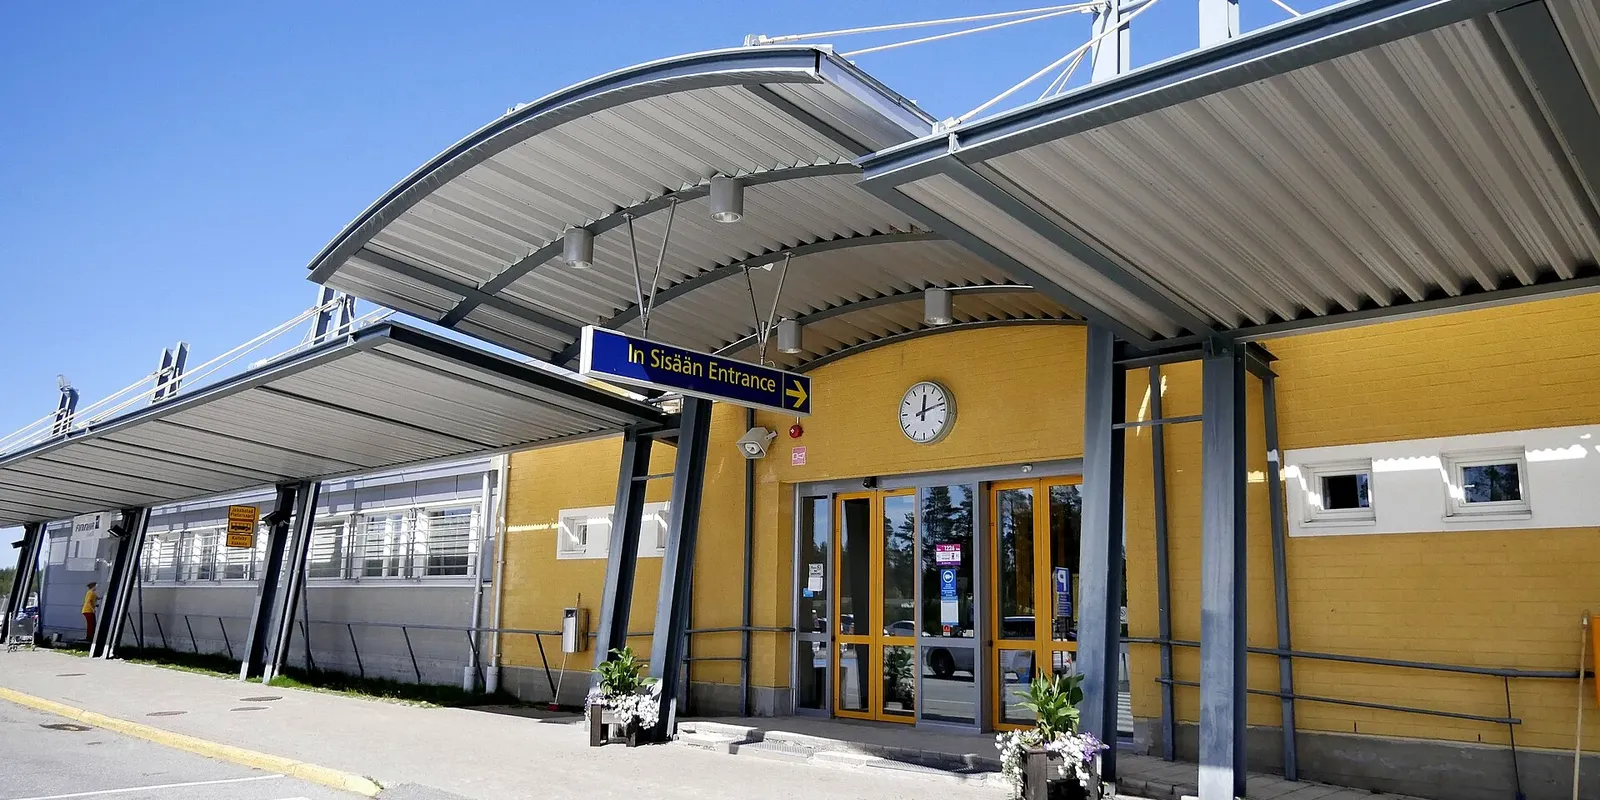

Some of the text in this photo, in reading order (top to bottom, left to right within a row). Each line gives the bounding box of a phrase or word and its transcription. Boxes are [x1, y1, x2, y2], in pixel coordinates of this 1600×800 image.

[628, 343, 776, 392] In Sisään Entrance
